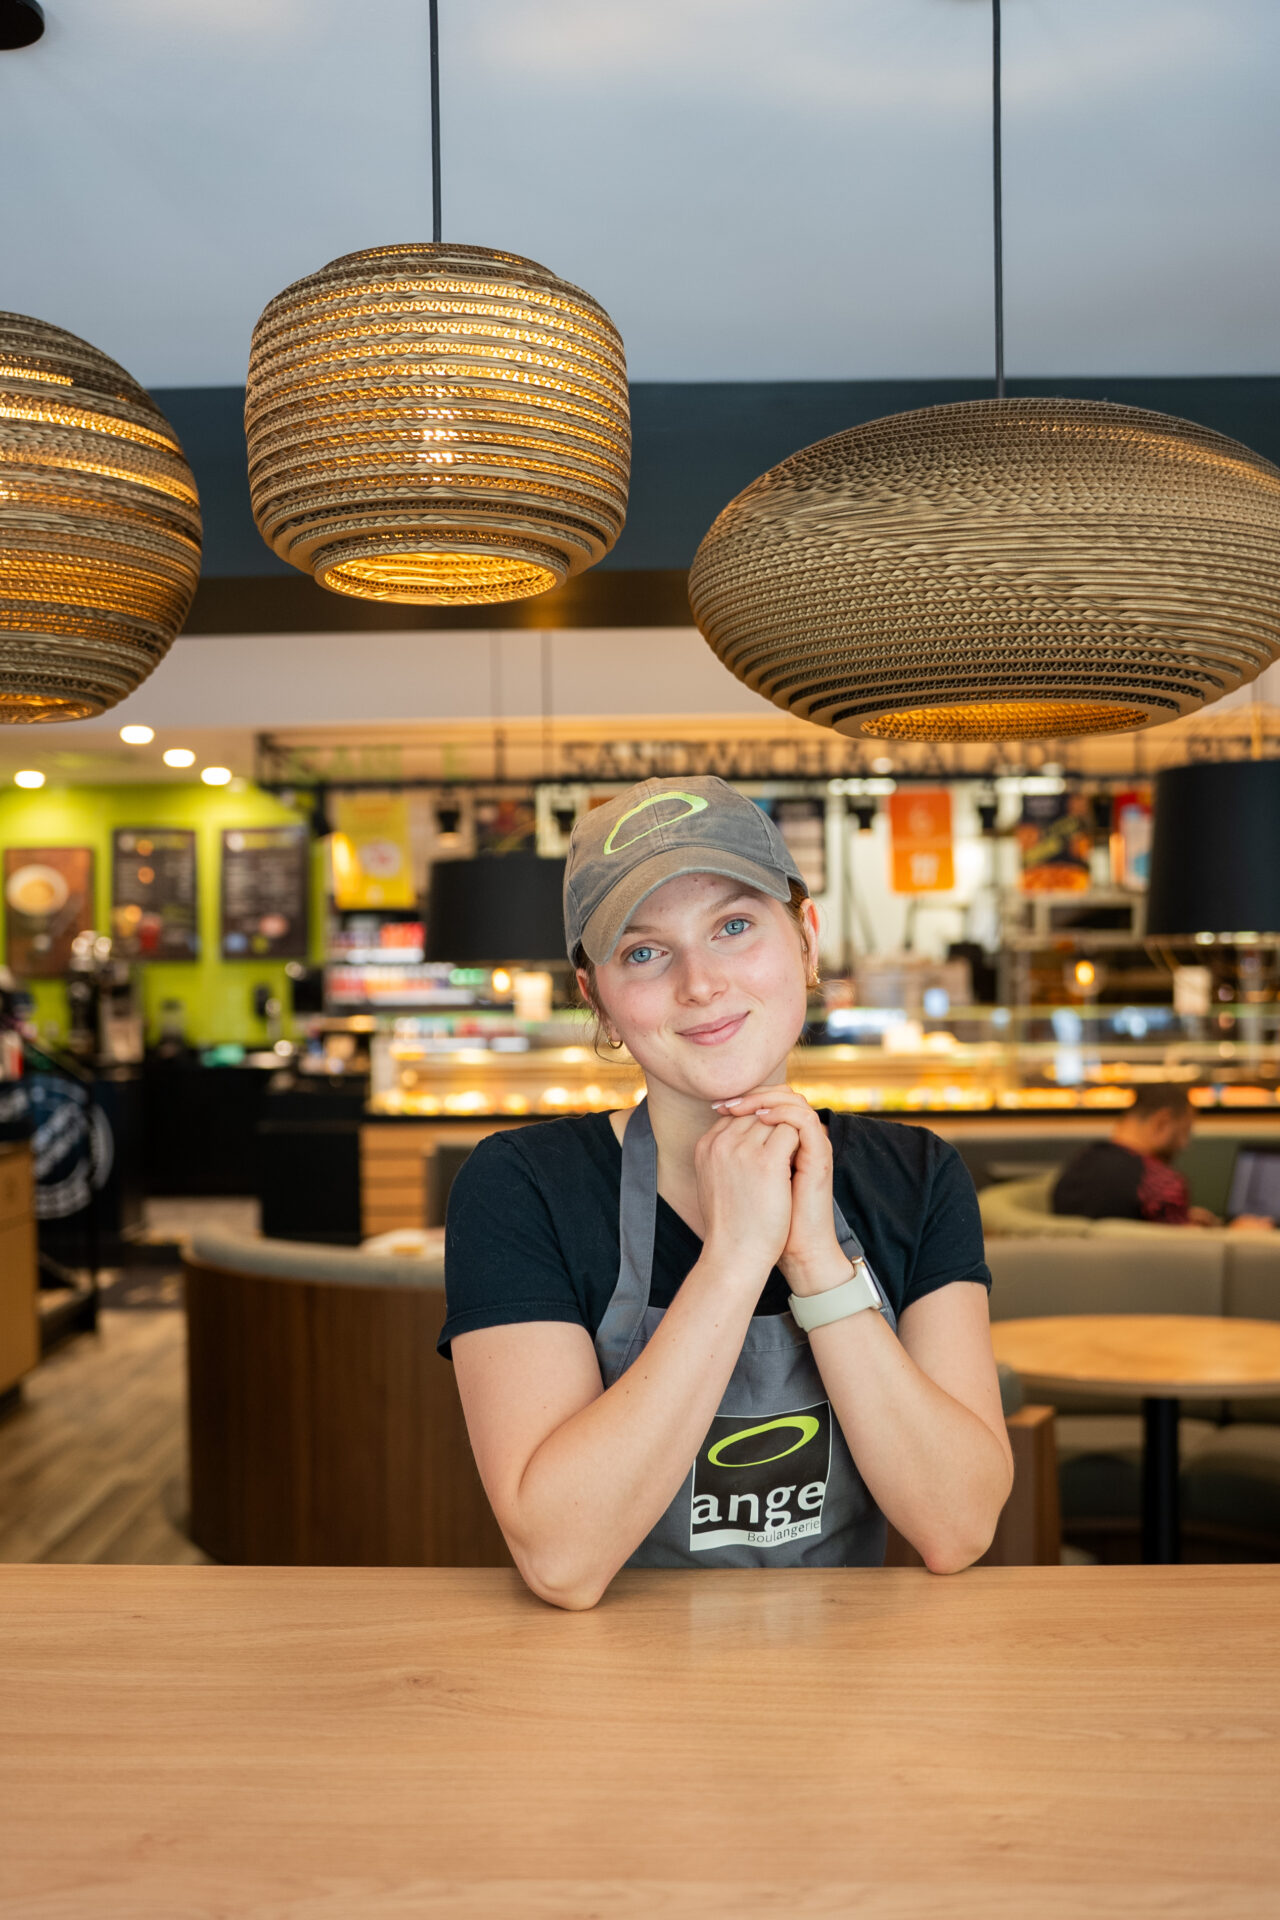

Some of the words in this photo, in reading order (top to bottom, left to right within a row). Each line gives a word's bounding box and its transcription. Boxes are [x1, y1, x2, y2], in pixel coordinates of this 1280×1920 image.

[561, 740, 830, 777] SANDWICH
[692, 1481, 825, 1532] ange
[747, 1519, 820, 1543] Boulangerie
